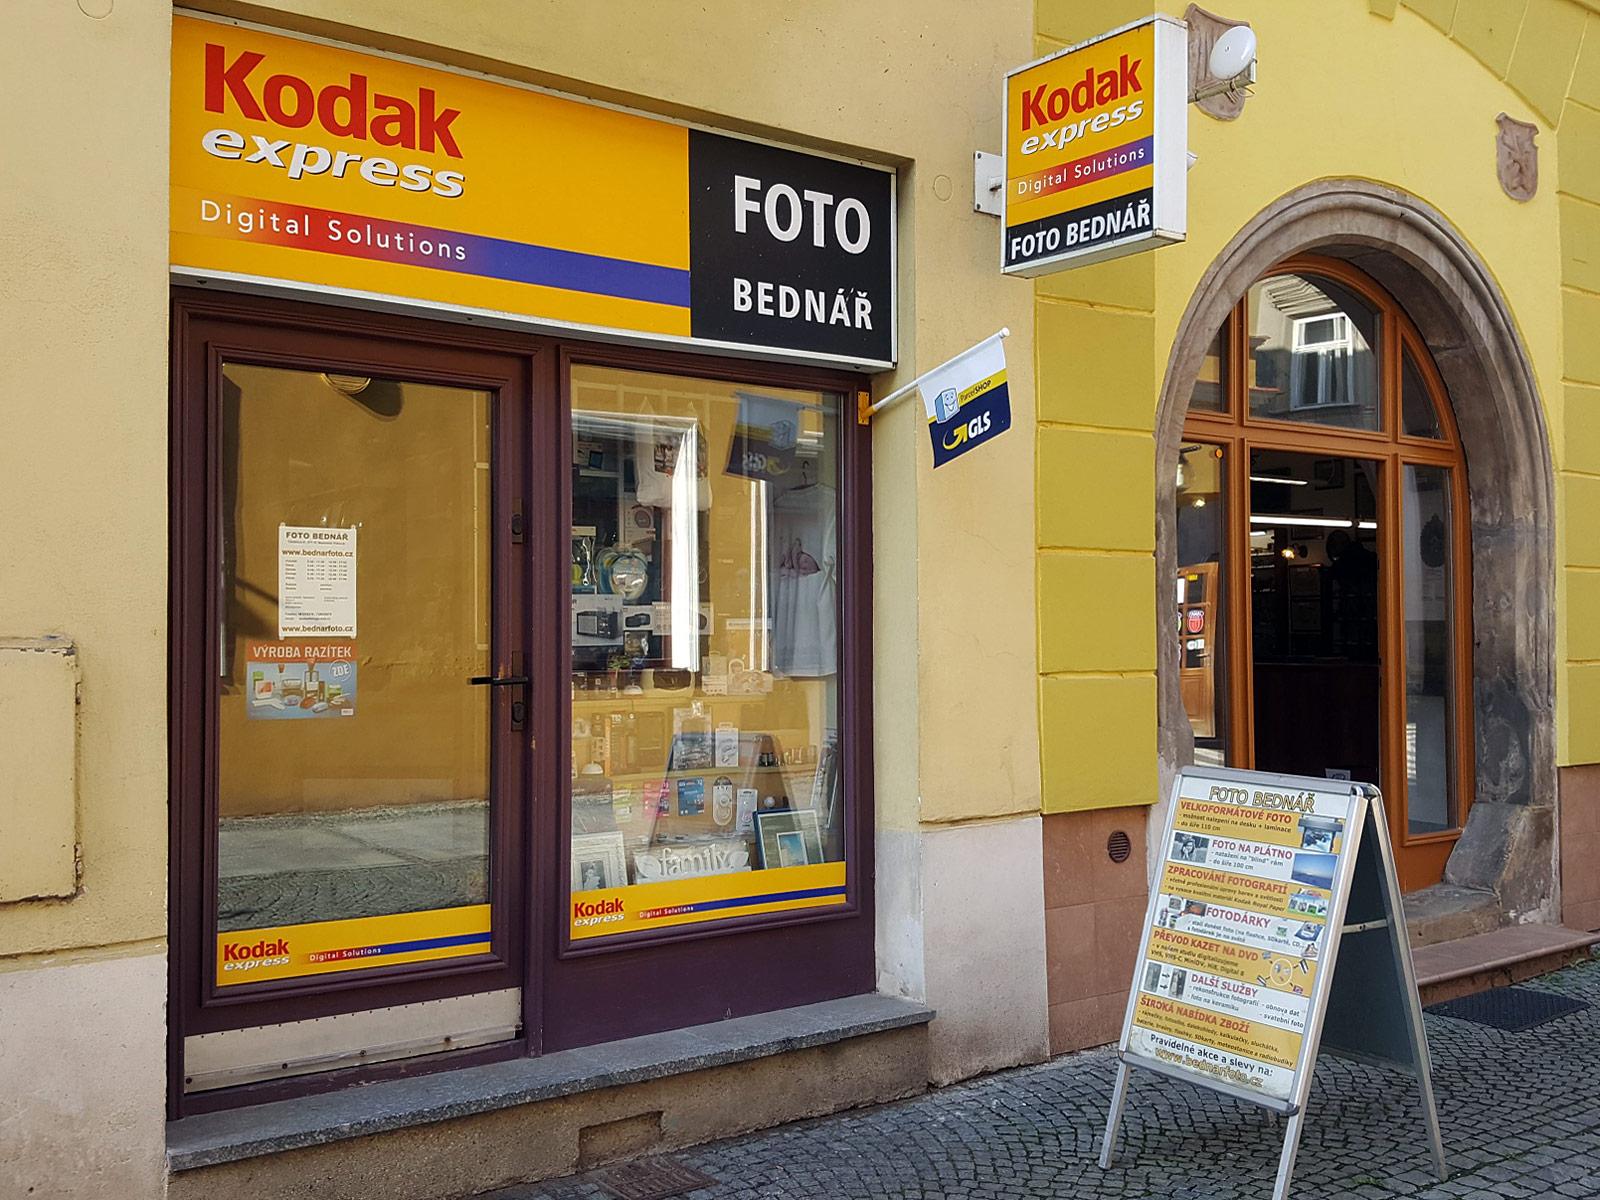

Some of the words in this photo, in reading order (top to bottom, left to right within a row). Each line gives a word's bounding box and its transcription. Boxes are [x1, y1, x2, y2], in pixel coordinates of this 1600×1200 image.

[204, 42, 464, 159] Kodak
[1021, 54, 1143, 131] Kodak
[1020, 99, 1144, 155] express
[201, 128, 465, 198] express
[1018, 169, 1067, 195] Digital
[1074, 147, 1145, 179] Solutions
[734, 174, 871, 255] FOTO
[201, 200, 309, 236] Digital
[327, 219, 466, 261] Solutions
[1011, 227, 1060, 260] FOTO
[1065, 198, 1150, 247] BEDNÁŘ
[733, 277, 873, 331] BEDNÁŘ
[968, 410, 991, 439] GLS
[286, 531, 310, 539] FOTO
[281, 549, 353, 558] www.bednarfoto.cz
[281, 625, 353, 633] www.bednarfoto.cz
[253, 644, 301, 658] VÝROBA
[304, 644, 352, 658] RAZÍTEK
[332, 664, 350, 677] ZDE
[1209, 785, 1249, 804] FOTO
[1251, 791, 1315, 813] BEDNÁŘ
[1180, 800, 1264, 819] VELKOFORMÁTOVÉ
[1265, 812, 1292, 823] FOTO
[1182, 813, 1205, 821] možnost
[1204, 816, 1230, 824] nalepení
[1239, 820, 1257, 828] desku
[1263, 824, 1291, 833] laminace
[1211, 839, 1236, 850] FOTO
[1238, 843, 1251, 852] NA
[1253, 844, 1293, 859] PLÁTNO
[1167, 863, 1226, 883] ZPRACOVÁNÍ
[1227, 874, 1288, 894] FOTOGRAFIÍ
[574, 897, 624, 918] Kodak
[639, 909, 662, 919] Digital
[664, 905, 694, 915] Solutions
[1205, 905, 1271, 928] FOTODÁRKY
[574, 913, 625, 927] express
[224, 938, 289, 961] Kodak
[309, 951, 339, 962] Digital
[341, 947, 382, 958] Solutions
[1153, 928, 1189, 945] PŘEVOD
[1190, 938, 1219, 952] KAZET
[1222, 946, 1235, 956] NA
[1237, 949, 1258, 961] DVD
[223, 956, 290, 971] express
[1191, 973, 1219, 988] DALŠÍ
[1221, 980, 1258, 997] SLUŽBY
[1192, 985, 1230, 1000] rekonstrukce
[1140, 995, 1174, 1013] ŠIROKÁ
[1176, 1004, 1217, 1024] NABÍDKA
[1219, 1016, 1250, 1033] ZBOŽÍ
[1263, 1012, 1289, 1025] svatební
[1290, 1019, 1303, 1028] foto
[1265, 1003, 1287, 1013] obnova
[1289, 1009, 1300, 1017] dat
[1150, 1033, 1195, 1054] Pravidelné
[1197, 1047, 1219, 1060] akce
[1230, 1056, 1255, 1071] slevy
[1257, 1064, 1273, 1076] na:
[1217, 1040, 1254, 1055] meteostanice
[1259, 1051, 1293, 1066] radiobudíky
[1154, 1047, 1263, 1088] www.bednarfoto.cz
